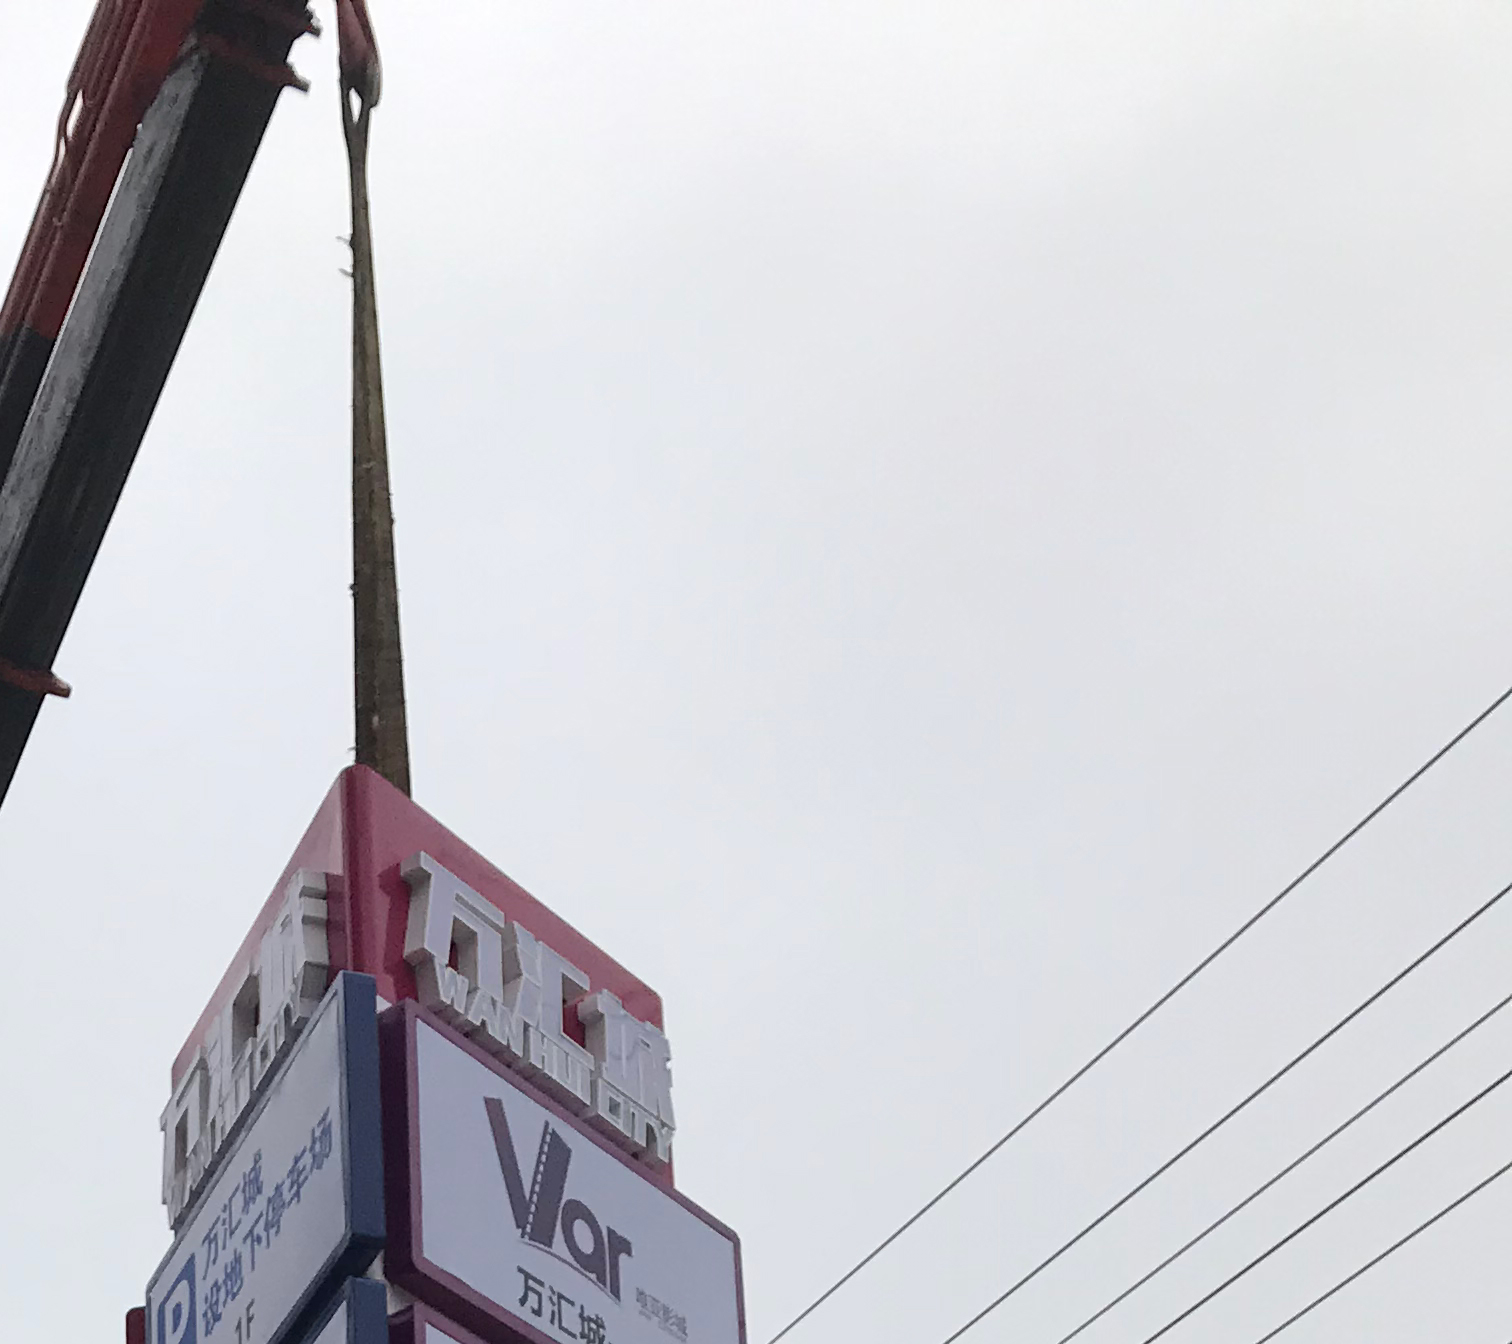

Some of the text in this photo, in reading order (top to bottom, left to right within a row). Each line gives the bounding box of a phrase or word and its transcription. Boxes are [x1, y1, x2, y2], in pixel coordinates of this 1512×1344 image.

[201, 1149, 263, 1280] 万汇城
[204, 1106, 334, 1337] 设地下停车场
